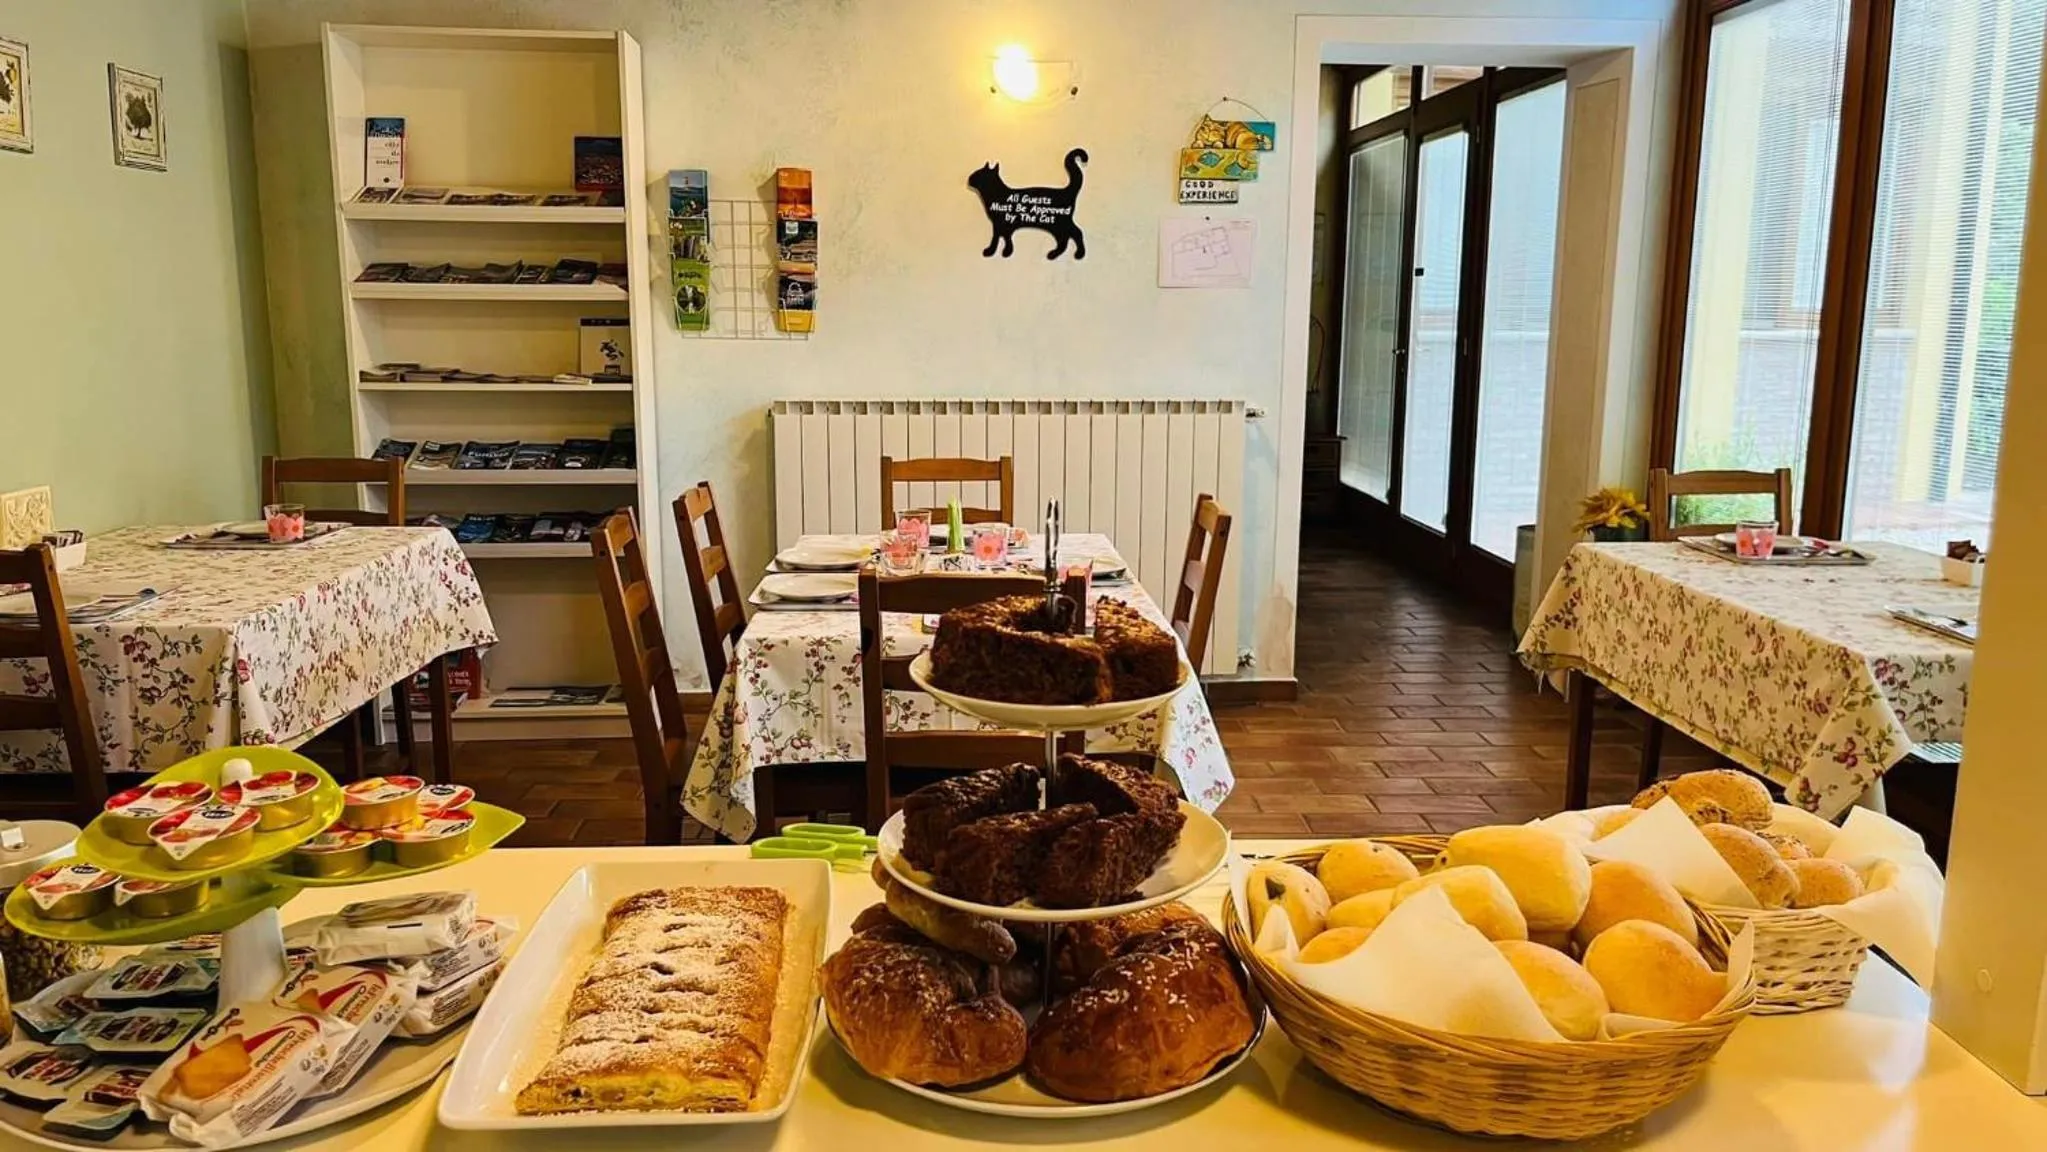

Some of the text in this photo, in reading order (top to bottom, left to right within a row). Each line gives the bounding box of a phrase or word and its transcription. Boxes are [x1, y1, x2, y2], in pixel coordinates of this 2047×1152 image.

[1006, 193, 1052, 204] All Guests
[1180, 190, 1236, 199] EXPERIENCE
[989, 202, 1072, 216] Must Be Approved
[1005, 213, 1055, 224] by The Cat
